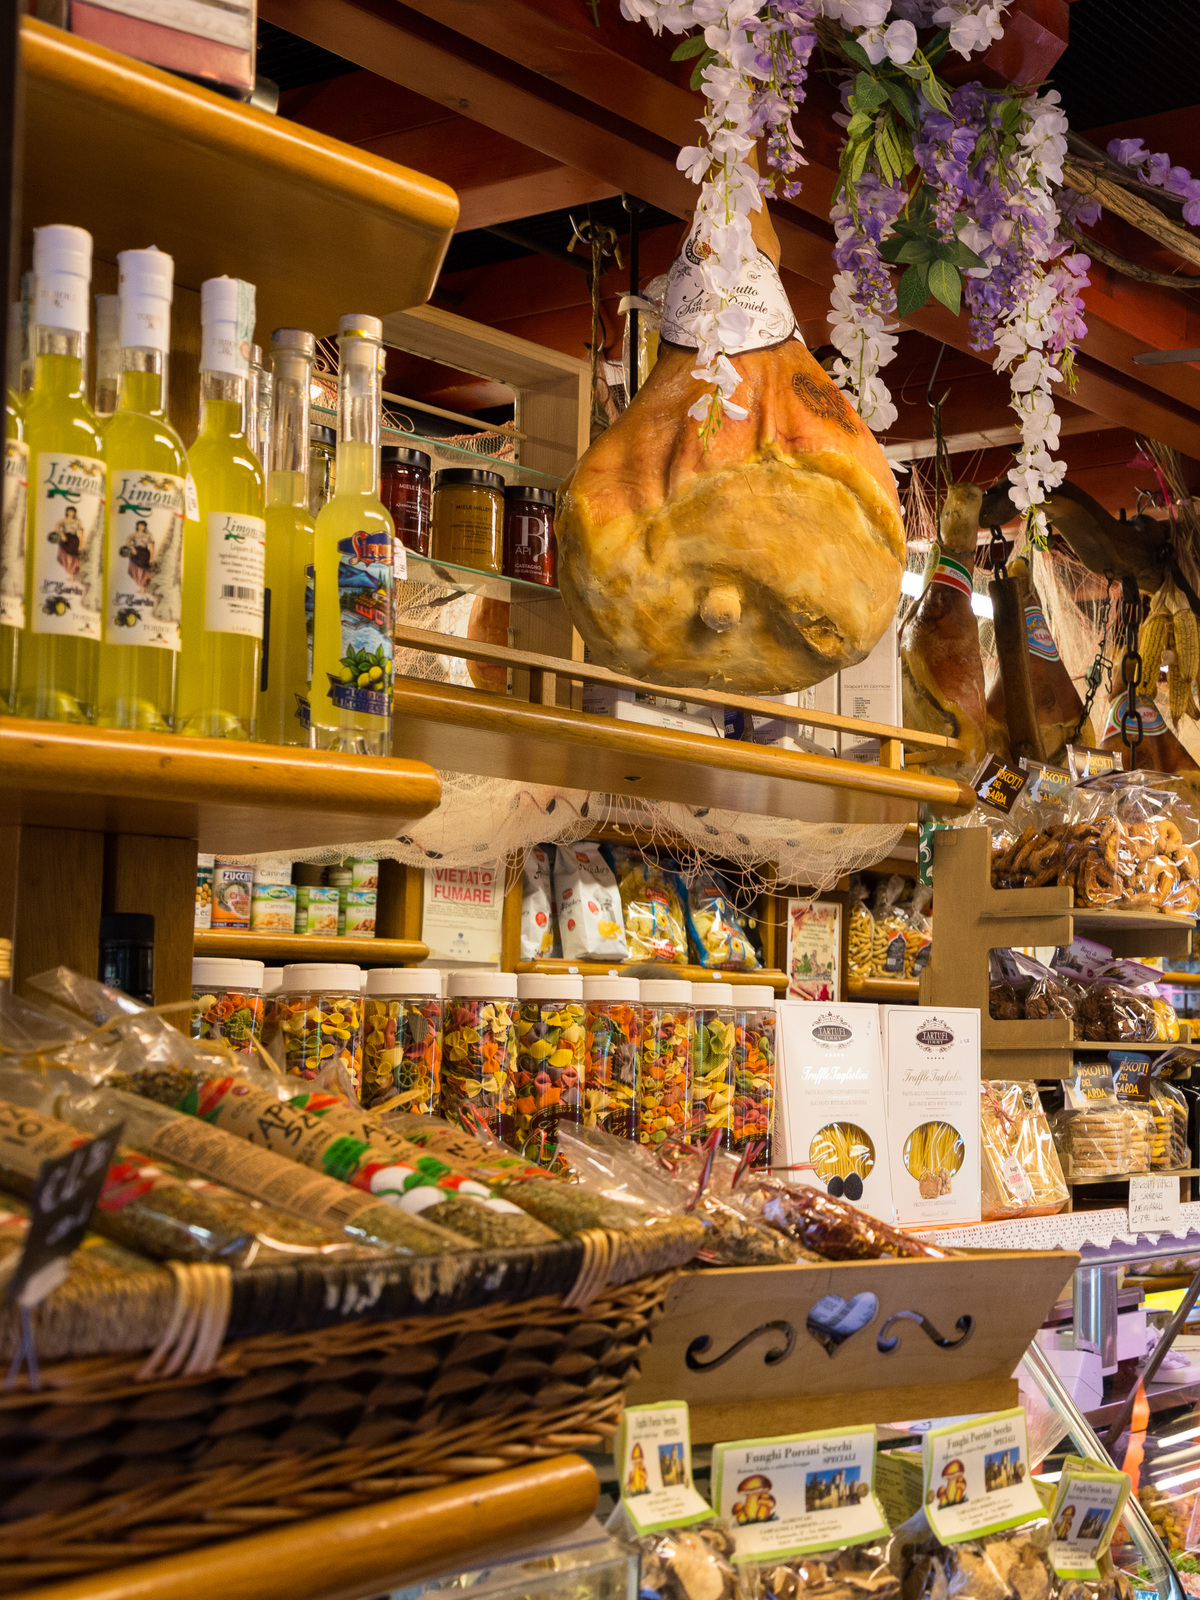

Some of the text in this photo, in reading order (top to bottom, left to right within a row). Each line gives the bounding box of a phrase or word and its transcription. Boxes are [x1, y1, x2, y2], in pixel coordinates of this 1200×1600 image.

[515, 546, 532, 556] API
[1086, 754, 1114, 769] BISCOTTI
[993, 780, 1003, 789] DEL
[998, 768, 1024, 788] BISCOTTI
[1040, 769, 1071, 786] BISCOTTI
[1041, 782, 1050, 790] DEL
[986, 788, 1007, 804] GARDA
[1038, 791, 1063, 805] GARDA
[435, 867, 493, 887] VIETATO
[434, 884, 492, 903] FUMARE
[818, 1027, 847, 1035] TARTUFI
[923, 1031, 948, 1040] TARTUFI
[1077, 1064, 1109, 1077] BISCOTTI
[1119, 1060, 1150, 1074] BISCOTTI
[801, 1066, 869, 1085] Truffle Tagliolini
[902, 1068, 931, 1087] Truffle
[1118, 1072, 1129, 1082] DEL
[1081, 1078, 1093, 1088] DEL
[1114, 1081, 1139, 1094] GARDA
[1081, 1087, 1109, 1099] GARDA
[947, 1422, 1012, 1449] Funghi Porcini Secchi
[745, 1440, 852, 1464] Funghi Porcini Secchi
[823, 1453, 857, 1464] SPECIALI
